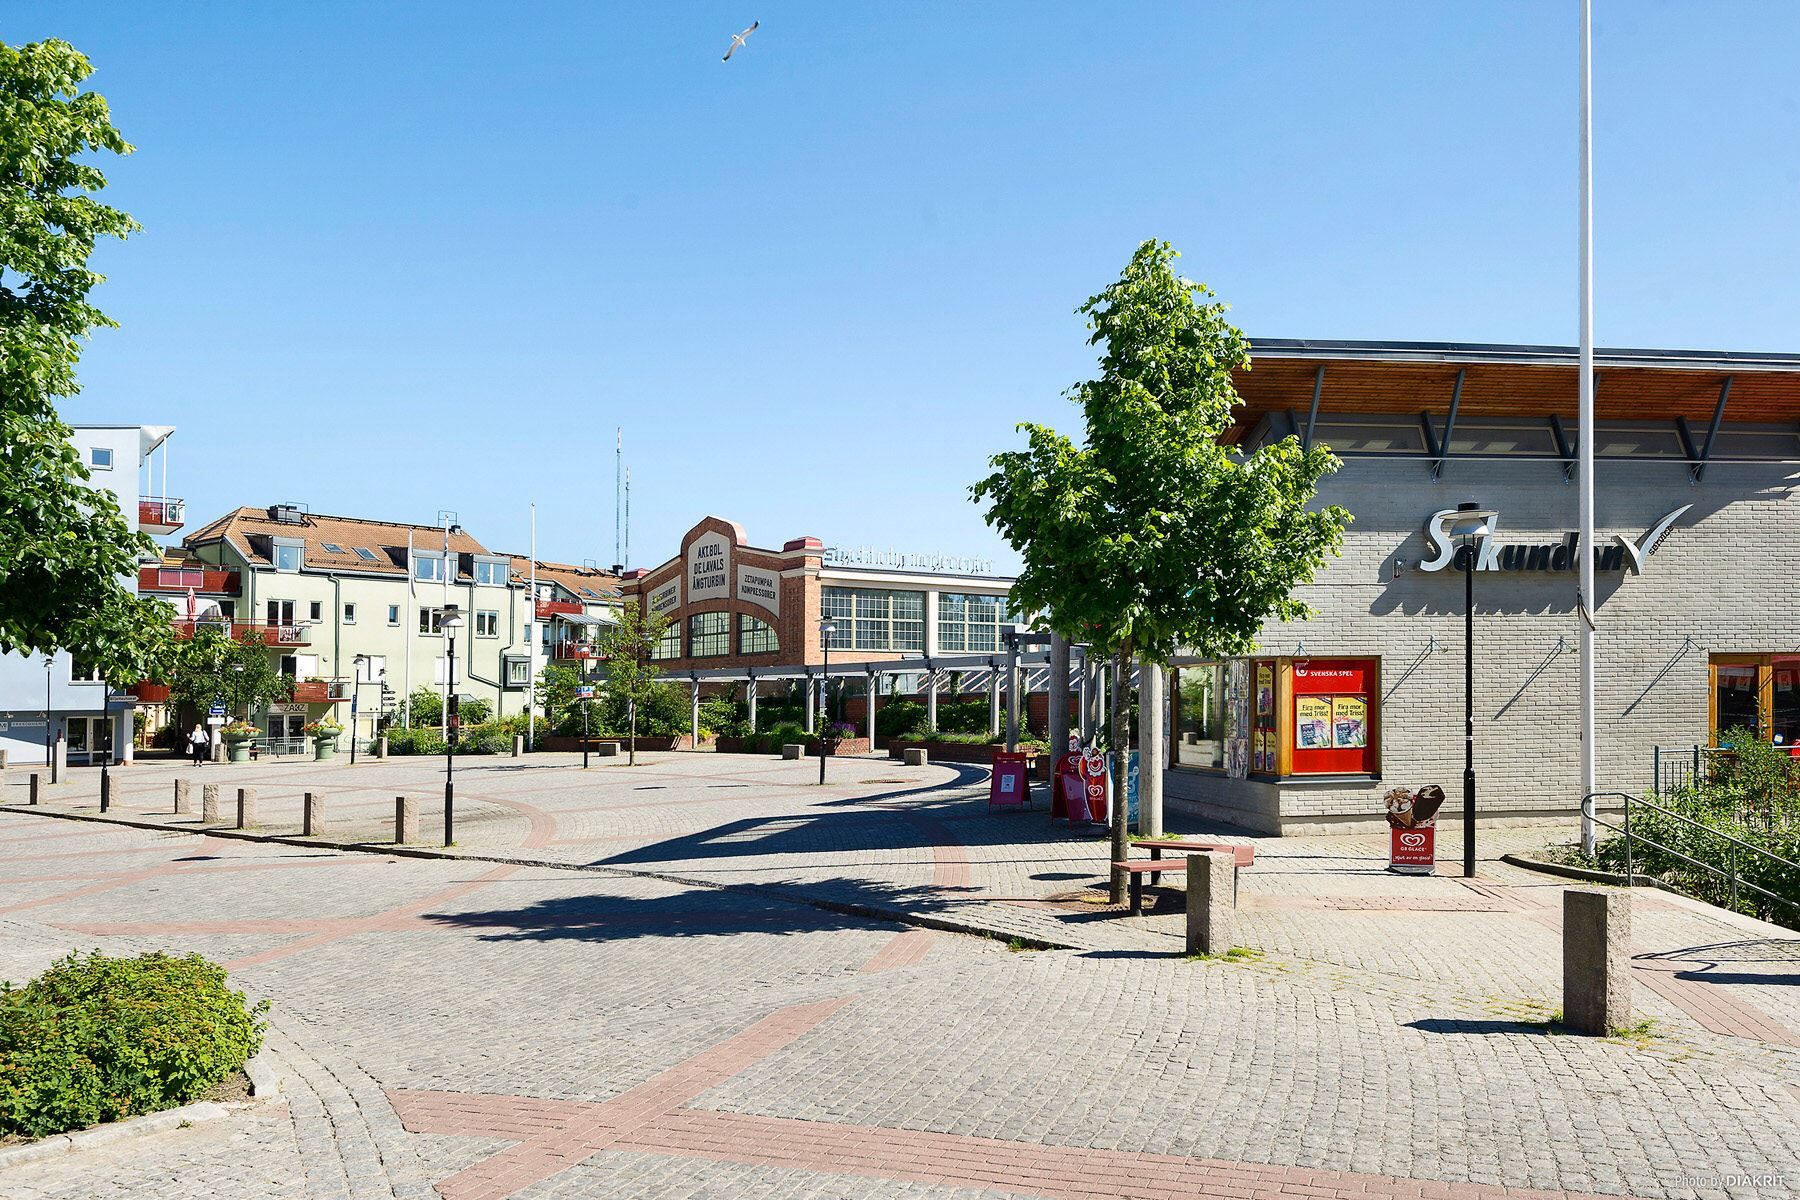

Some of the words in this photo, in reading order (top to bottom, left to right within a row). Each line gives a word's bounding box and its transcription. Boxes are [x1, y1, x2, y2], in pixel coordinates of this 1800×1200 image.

[1419, 509, 1624, 572] Sekundn
[1648, 524, 1675, 557] service
[694, 562, 702, 575] DE
[702, 558, 724, 574] LAVALS
[692, 573, 726, 591] ÅNGTURBIN
[744, 574, 773, 588] ZETAPUMPAR
[741, 585, 777, 600] KOMPRESSORER
